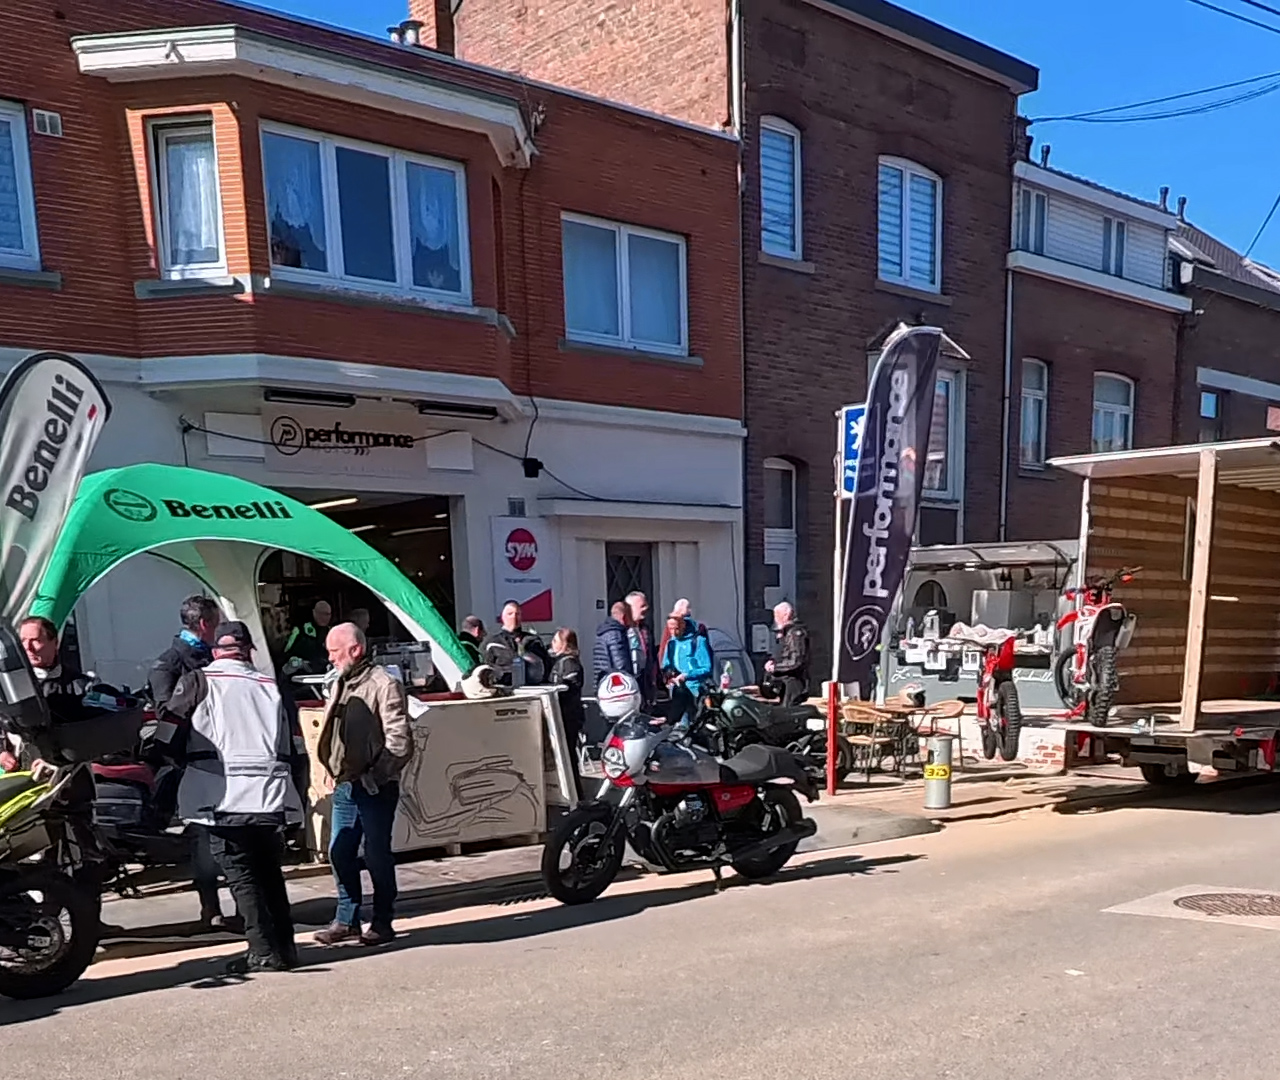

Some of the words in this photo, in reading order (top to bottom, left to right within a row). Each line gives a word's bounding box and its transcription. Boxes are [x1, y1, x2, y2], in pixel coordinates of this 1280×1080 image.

[5, 373, 84, 522] Benelli
[305, 422, 414, 448] performance
[862, 368, 908, 598] performance
[160, 499, 294, 520] Benelli
[505, 542, 536, 562] SYM
